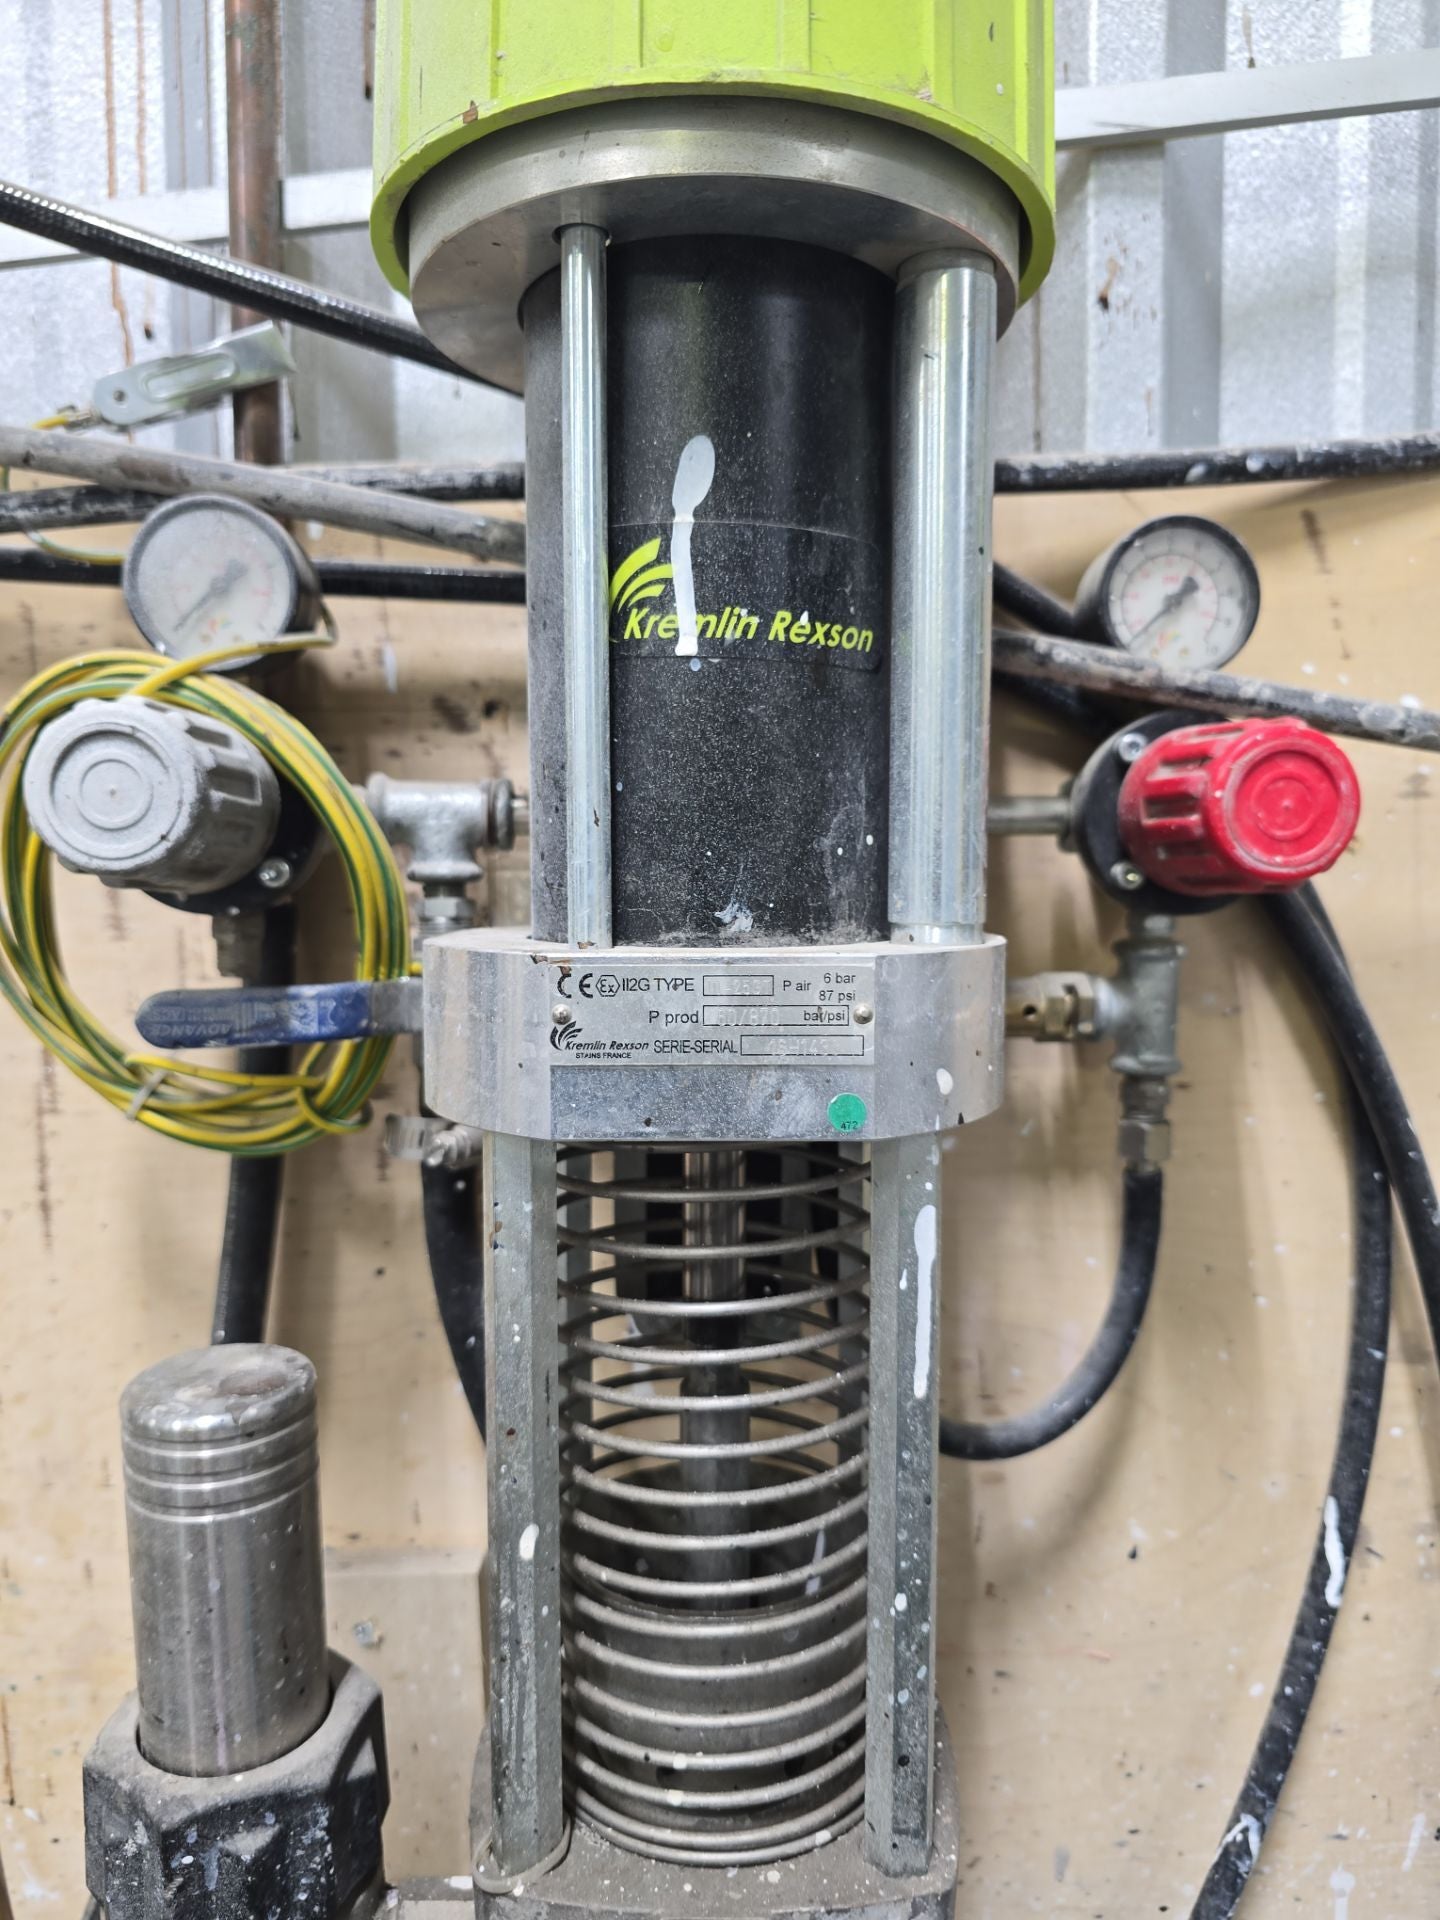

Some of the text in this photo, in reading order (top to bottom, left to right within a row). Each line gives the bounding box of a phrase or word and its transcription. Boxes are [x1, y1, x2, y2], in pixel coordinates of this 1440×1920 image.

[768, 611, 873, 652] Rexson
[654, 978, 695, 991] TYPE
[823, 973, 856, 984] 6 bar
[783, 980, 792, 991] P
[796, 980, 811, 991] air
[819, 990, 856, 1003] 87 psi
[649, 1010, 660, 1024] P
[665, 1010, 699, 1027] prod
[804, 1010, 845, 1023] bar/psi
[564, 1041, 649, 1051] Kremlin Rexson
[654, 1040, 738, 1054] SERIE-SERIAL
